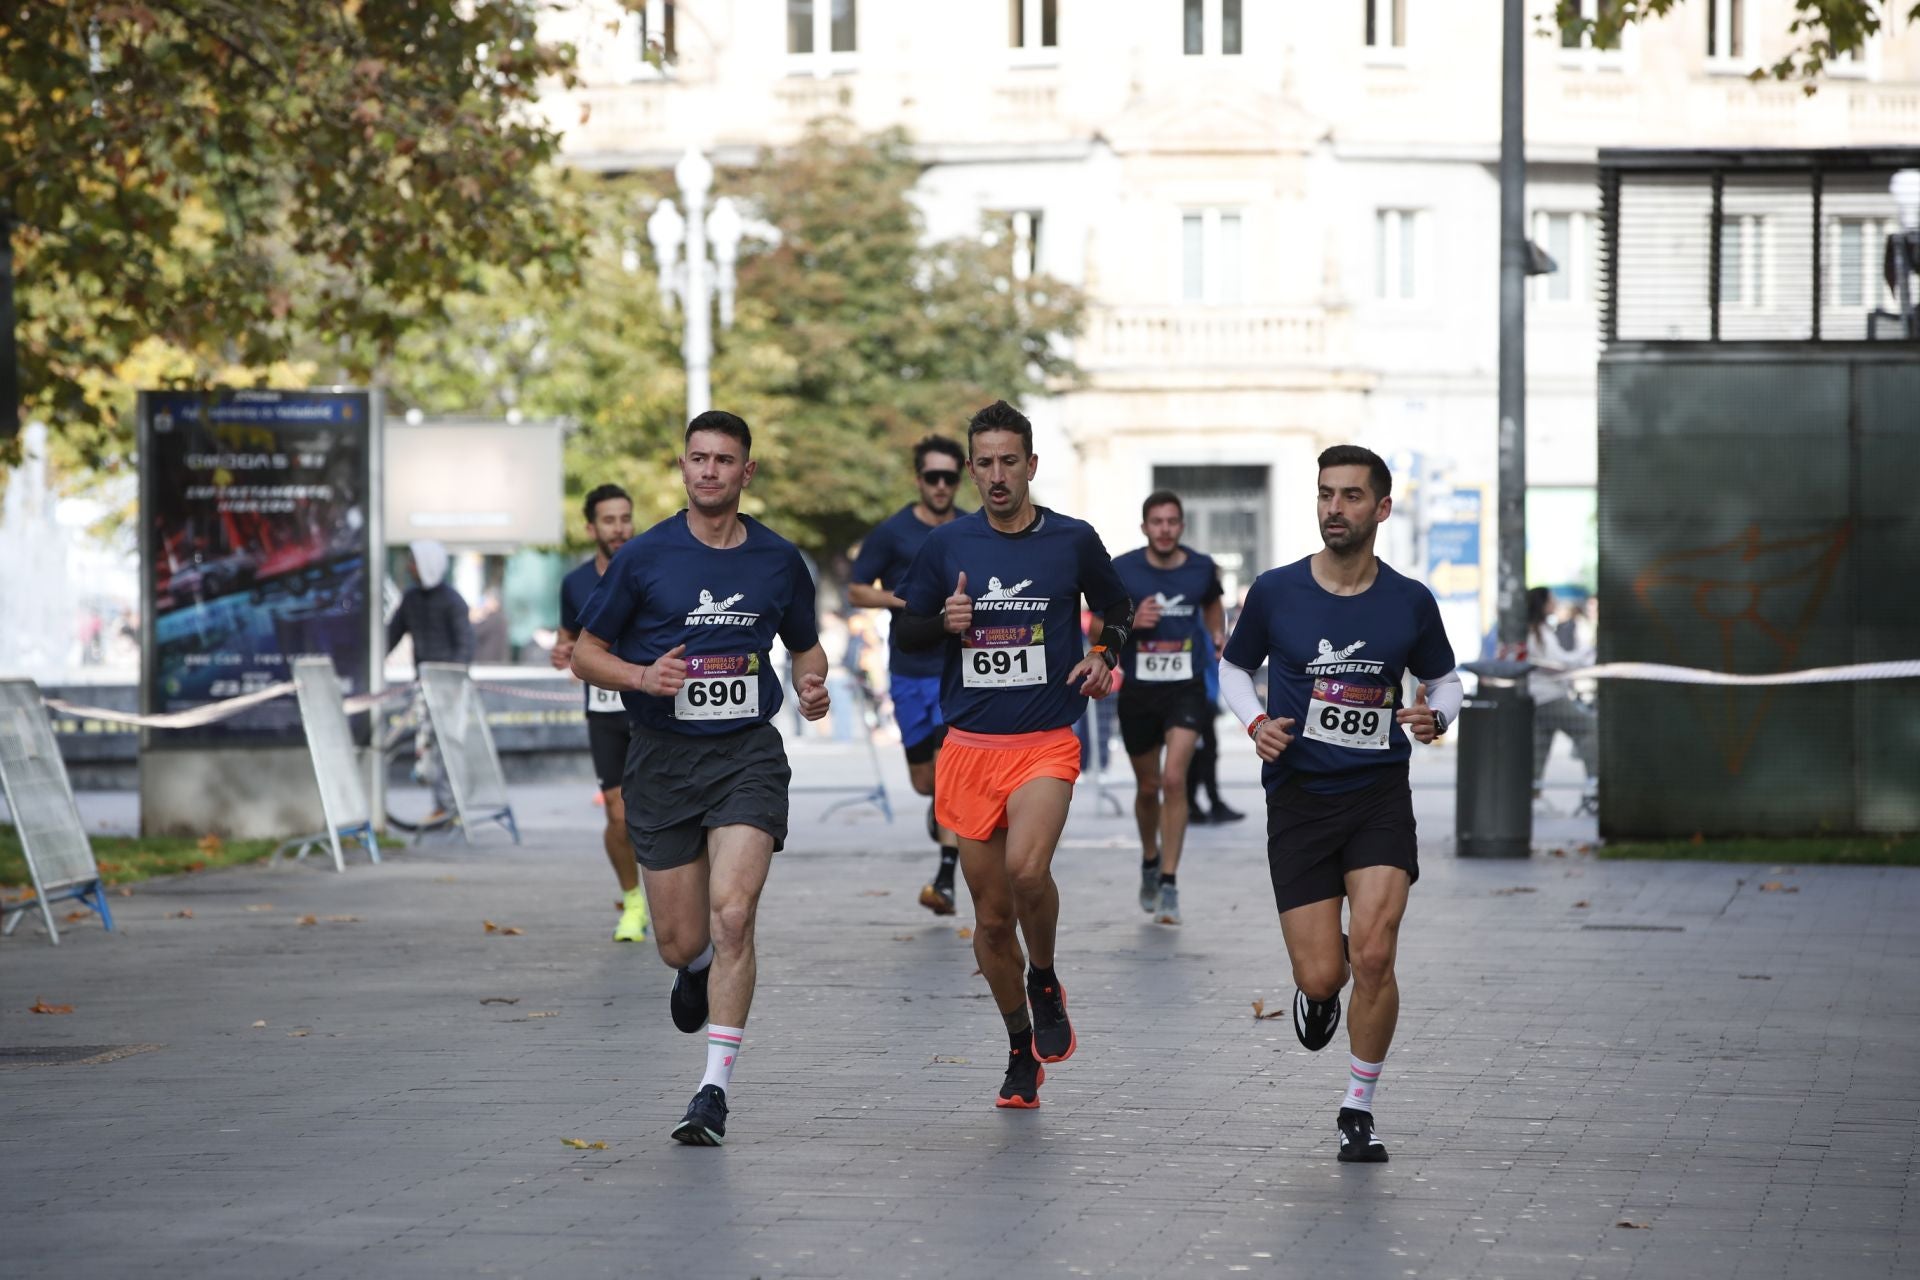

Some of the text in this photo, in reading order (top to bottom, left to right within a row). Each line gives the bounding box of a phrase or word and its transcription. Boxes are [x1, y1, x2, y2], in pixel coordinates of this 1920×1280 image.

[974, 601, 1049, 611] MICHELIN
[684, 615, 758, 627] MICHELIN
[703, 662, 736, 671] EMPRESAS
[973, 649, 1028, 675] 691
[1145, 656, 1183, 672] 676
[1305, 664, 1383, 675] MICHELIN
[687, 680, 747, 707] 690
[1320, 706, 1380, 736] 689
